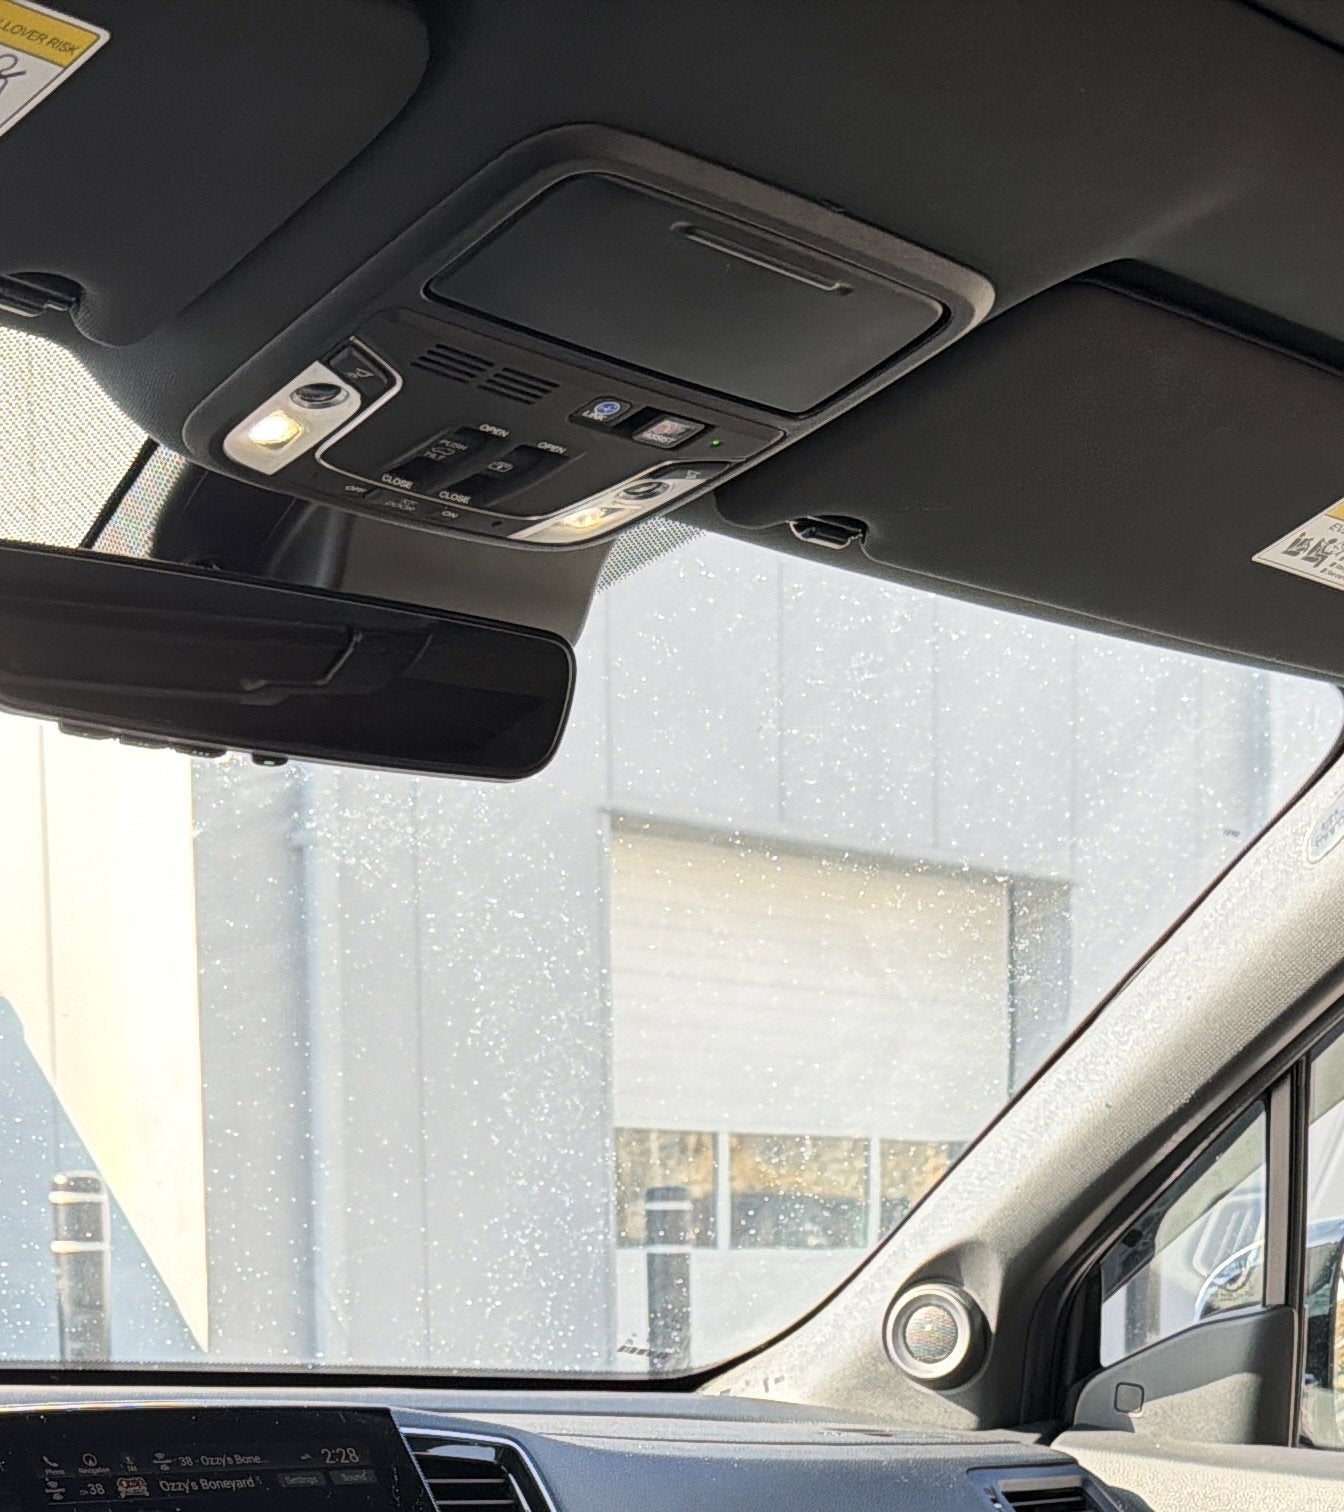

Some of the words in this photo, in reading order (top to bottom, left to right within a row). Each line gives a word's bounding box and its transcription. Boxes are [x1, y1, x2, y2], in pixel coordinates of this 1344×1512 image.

[47, 38, 79, 55] RISK
[479, 423, 509, 439] OPEN
[438, 439, 468, 451] PUSH
[537, 441, 567, 455] OPEN
[381, 473, 415, 490] CLOSE
[438, 490, 472, 505] CLOSE
[441, 509, 459, 519] ON
[178, 1456, 194, 1467] 38
[200, 1454, 233, 1468] Ozzy's
[320, 1447, 360, 1464] 2:28
[87, 1482, 106, 1496] 38
[159, 1478, 198, 1494] Ozzy's
[199, 1476, 255, 1492] Boneyard
